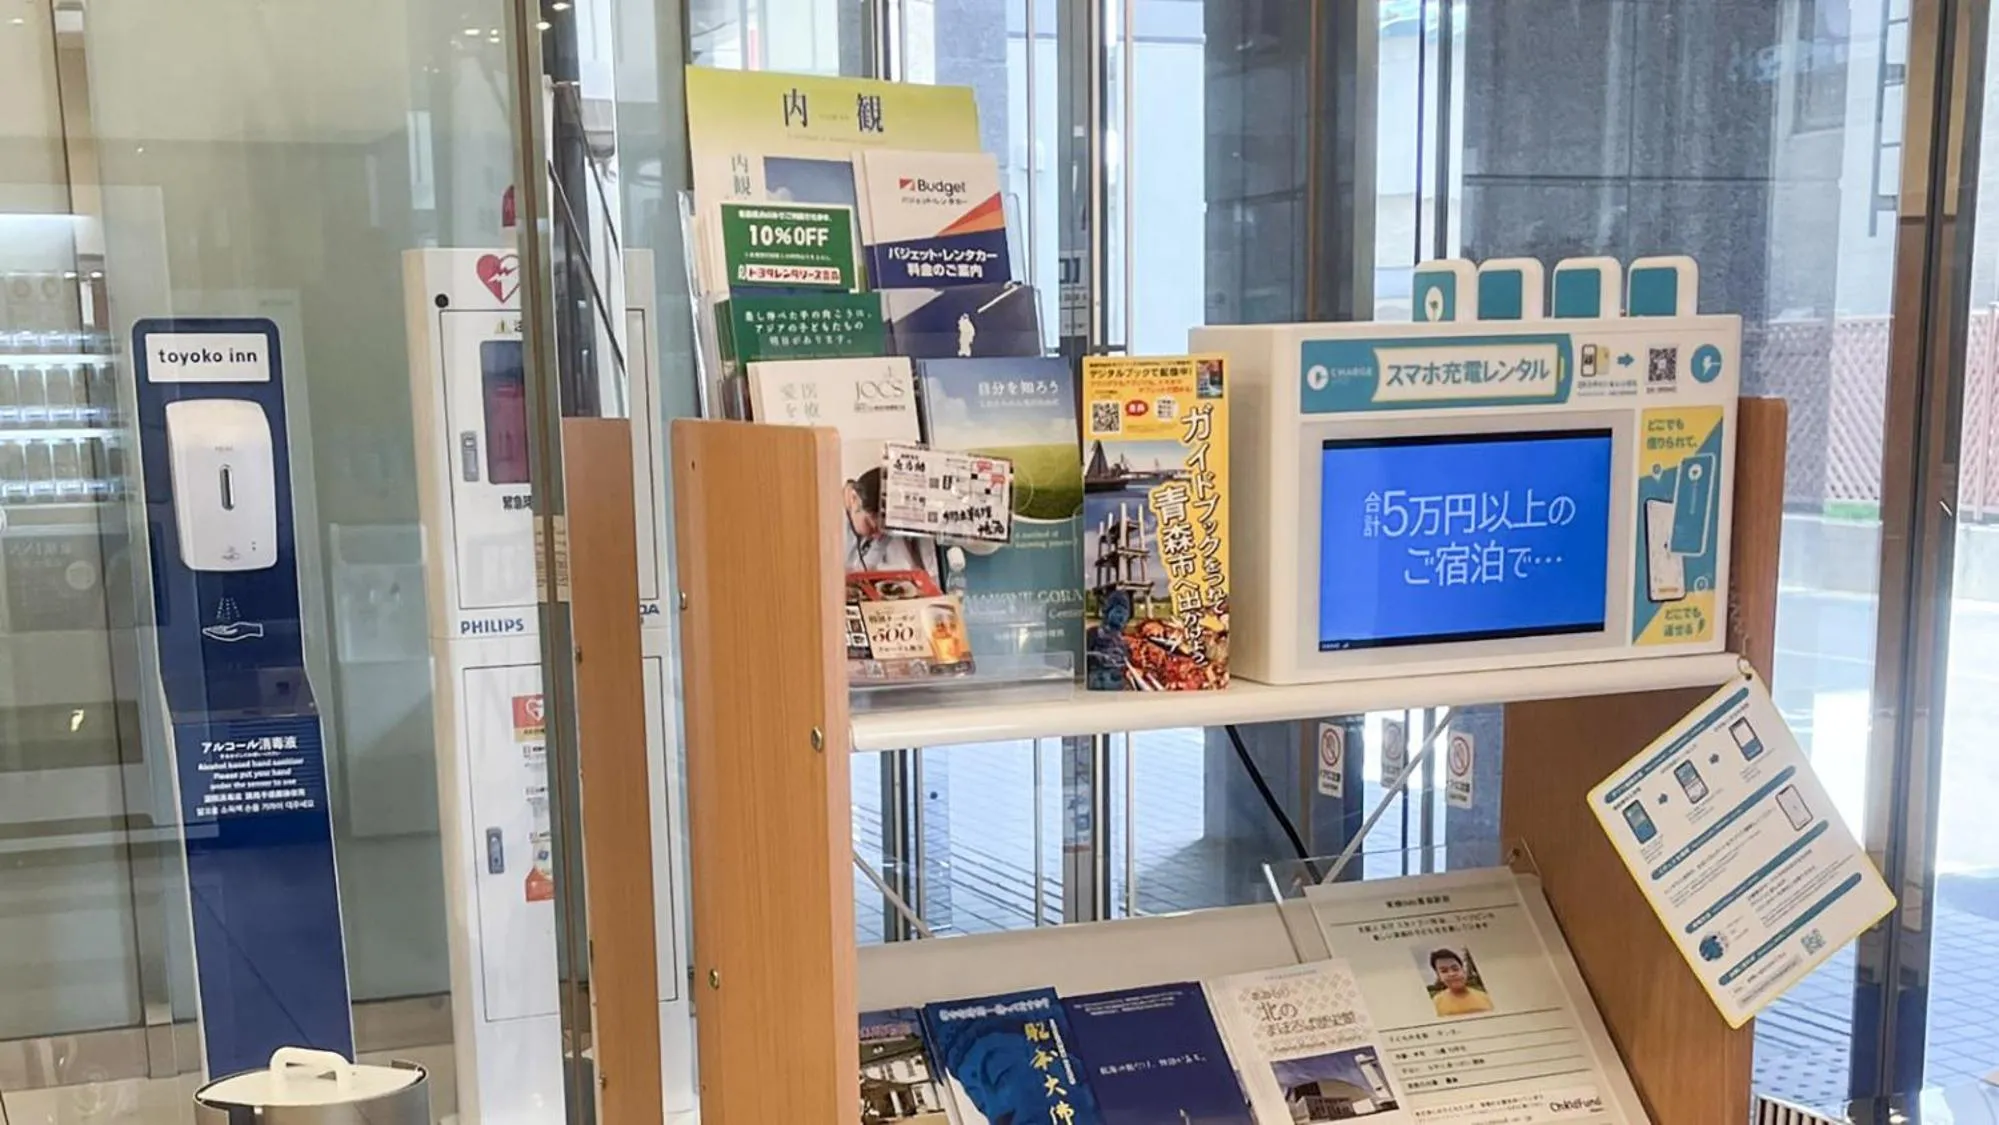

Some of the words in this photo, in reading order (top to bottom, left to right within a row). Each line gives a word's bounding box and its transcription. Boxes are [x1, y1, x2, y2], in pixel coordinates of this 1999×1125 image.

[917, 179, 966, 197] Budget
[749, 224, 829, 247] 10%OFF
[906, 262, 983, 278] 料金のご案内
[158, 348, 223, 366] toyoko
[229, 347, 257, 362] inn
[1386, 357, 1550, 387] スマホ充電レンタル
[1647, 417, 1685, 432] どこでも
[461, 618, 524, 634] PHILIPS
[872, 625, 914, 643] 500
[201, 736, 298, 754] アルコール消毒液
